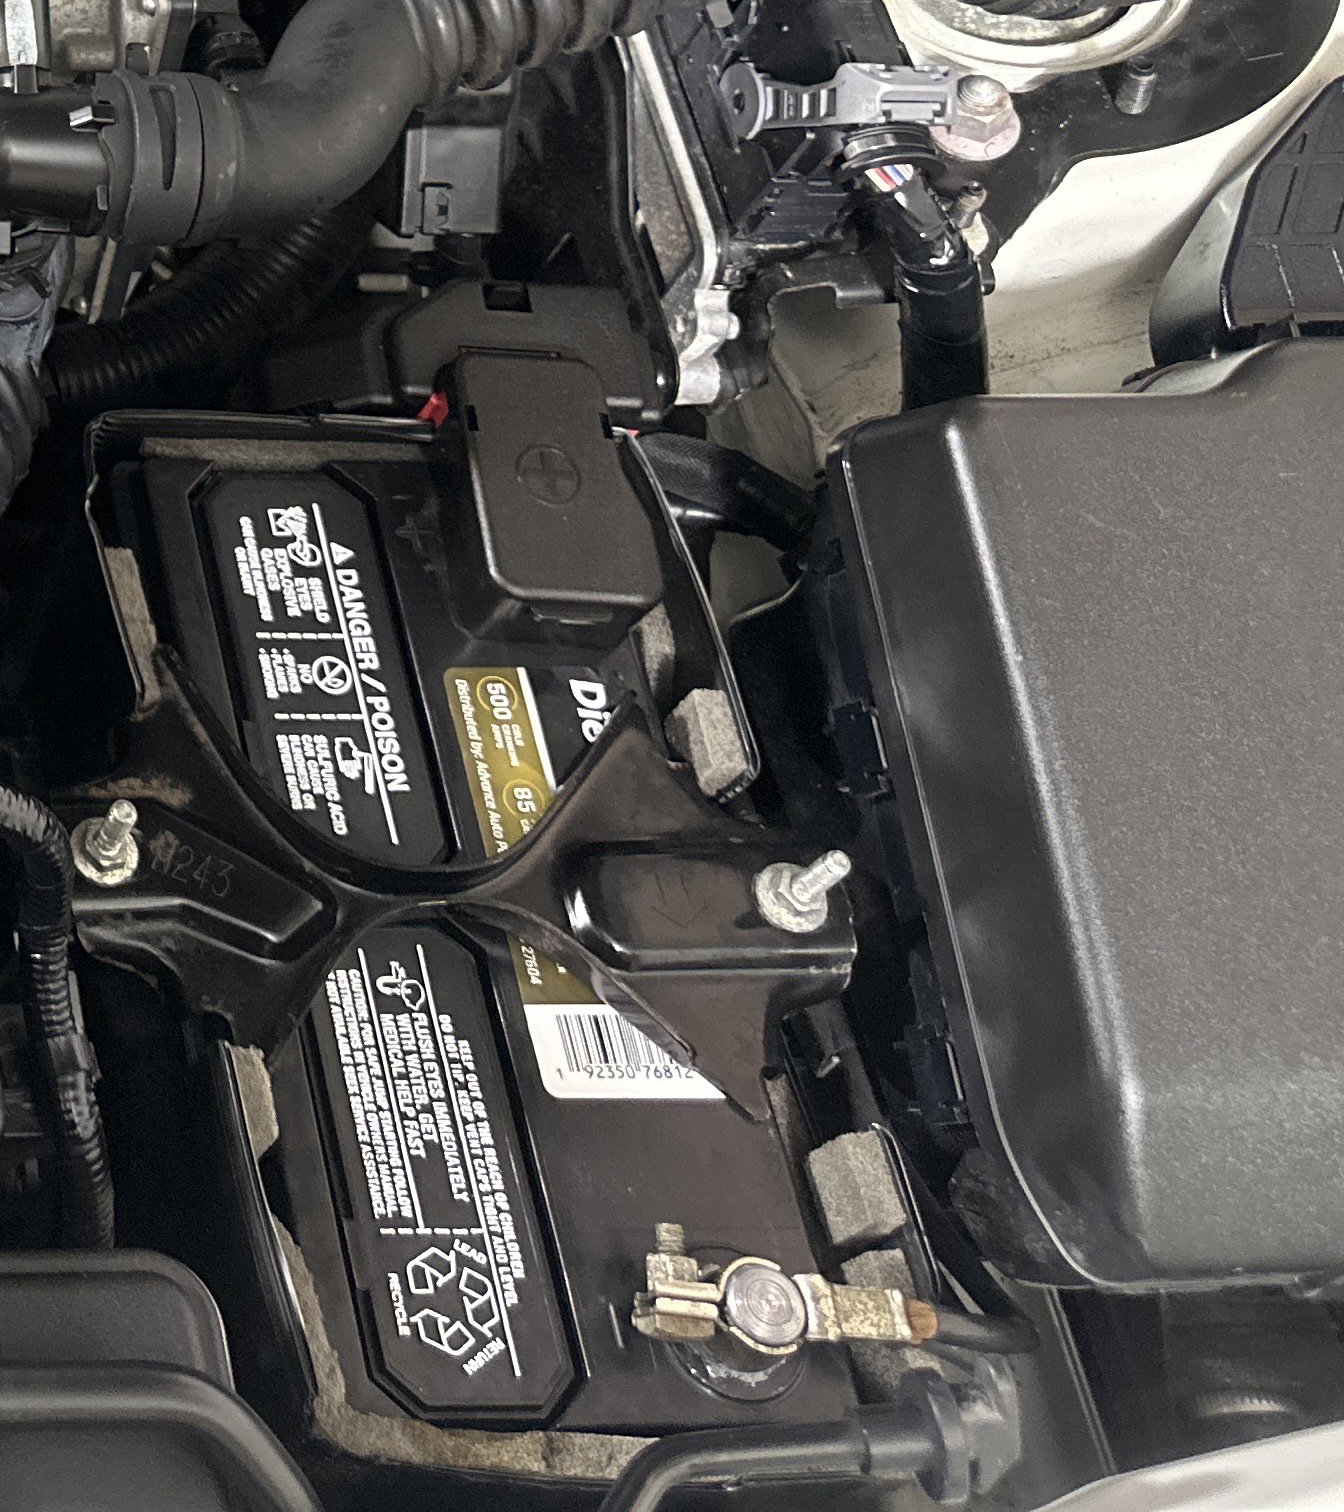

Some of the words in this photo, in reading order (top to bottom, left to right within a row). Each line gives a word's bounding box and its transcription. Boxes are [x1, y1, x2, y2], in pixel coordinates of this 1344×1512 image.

[260, 548, 281, 591] GASES
[272, 548, 302, 617] EXPLOSIVE
[293, 578, 313, 612] EYES
[297, 664, 314, 684] NO
[336, 569, 380, 669] DANGER
[366, 696, 410, 791] POISON
[455, 679, 482, 741] Distributed
[487, 680, 513, 720] 500
[301, 734, 316, 757] CAN
[470, 740, 484, 759] by:
[312, 735, 340, 801] SULFURIC
[328, 802, 348, 835] ACID
[476, 761, 496, 809] Advance
[514, 785, 536, 812] 85
[488, 810, 503, 838] Auto
[522, 946, 542, 984] 27604
[396, 1013, 417, 1051] WITH
[412, 1013, 436, 1060] FLUSH
[439, 1014, 453, 1033] DO
[380, 1014, 406, 1077] MEDICAL
[443, 1035, 459, 1059] NOT
[458, 1040, 475, 1070] KEEP
[402, 1054, 429, 1110] WATER.
[423, 1062, 445, 1099] EYES
[466, 1073, 482, 1099] OUT
[556, 1068, 564, 1079] 1
[584, 1065, 636, 1079] 92350
[642, 1065, 694, 1079] 76812
[394, 1079, 416, 1117] HELP
[454, 1090, 474, 1122] KEEP
[470, 1101, 487, 1118] OF
[365, 1047, 382, 1078] SAFE
[392, 1168, 413, 1218] FOLLOW
[403, 1120, 426, 1159] FAST
[418, 1113, 439, 1143] GET
[465, 1123, 483, 1155] VENT
[477, 1120, 494, 1145] THE
[432, 1102, 470, 1203] IMMEDIATELY
[482, 1148, 504, 1190] REACH
[473, 1159, 491, 1193] CAPS
[482, 1195, 501, 1233] TIGHT
[493, 1192, 509, 1212] OF
[453, 1238, 488, 1266] LEAD
[492, 1236, 508, 1263] AND
[499, 1212, 525, 1278] CHILDREN
[387, 1271, 412, 1338] RECYCLE
[498, 1265, 518, 1307] LEVEL
[463, 1336, 504, 1376] RETURN
